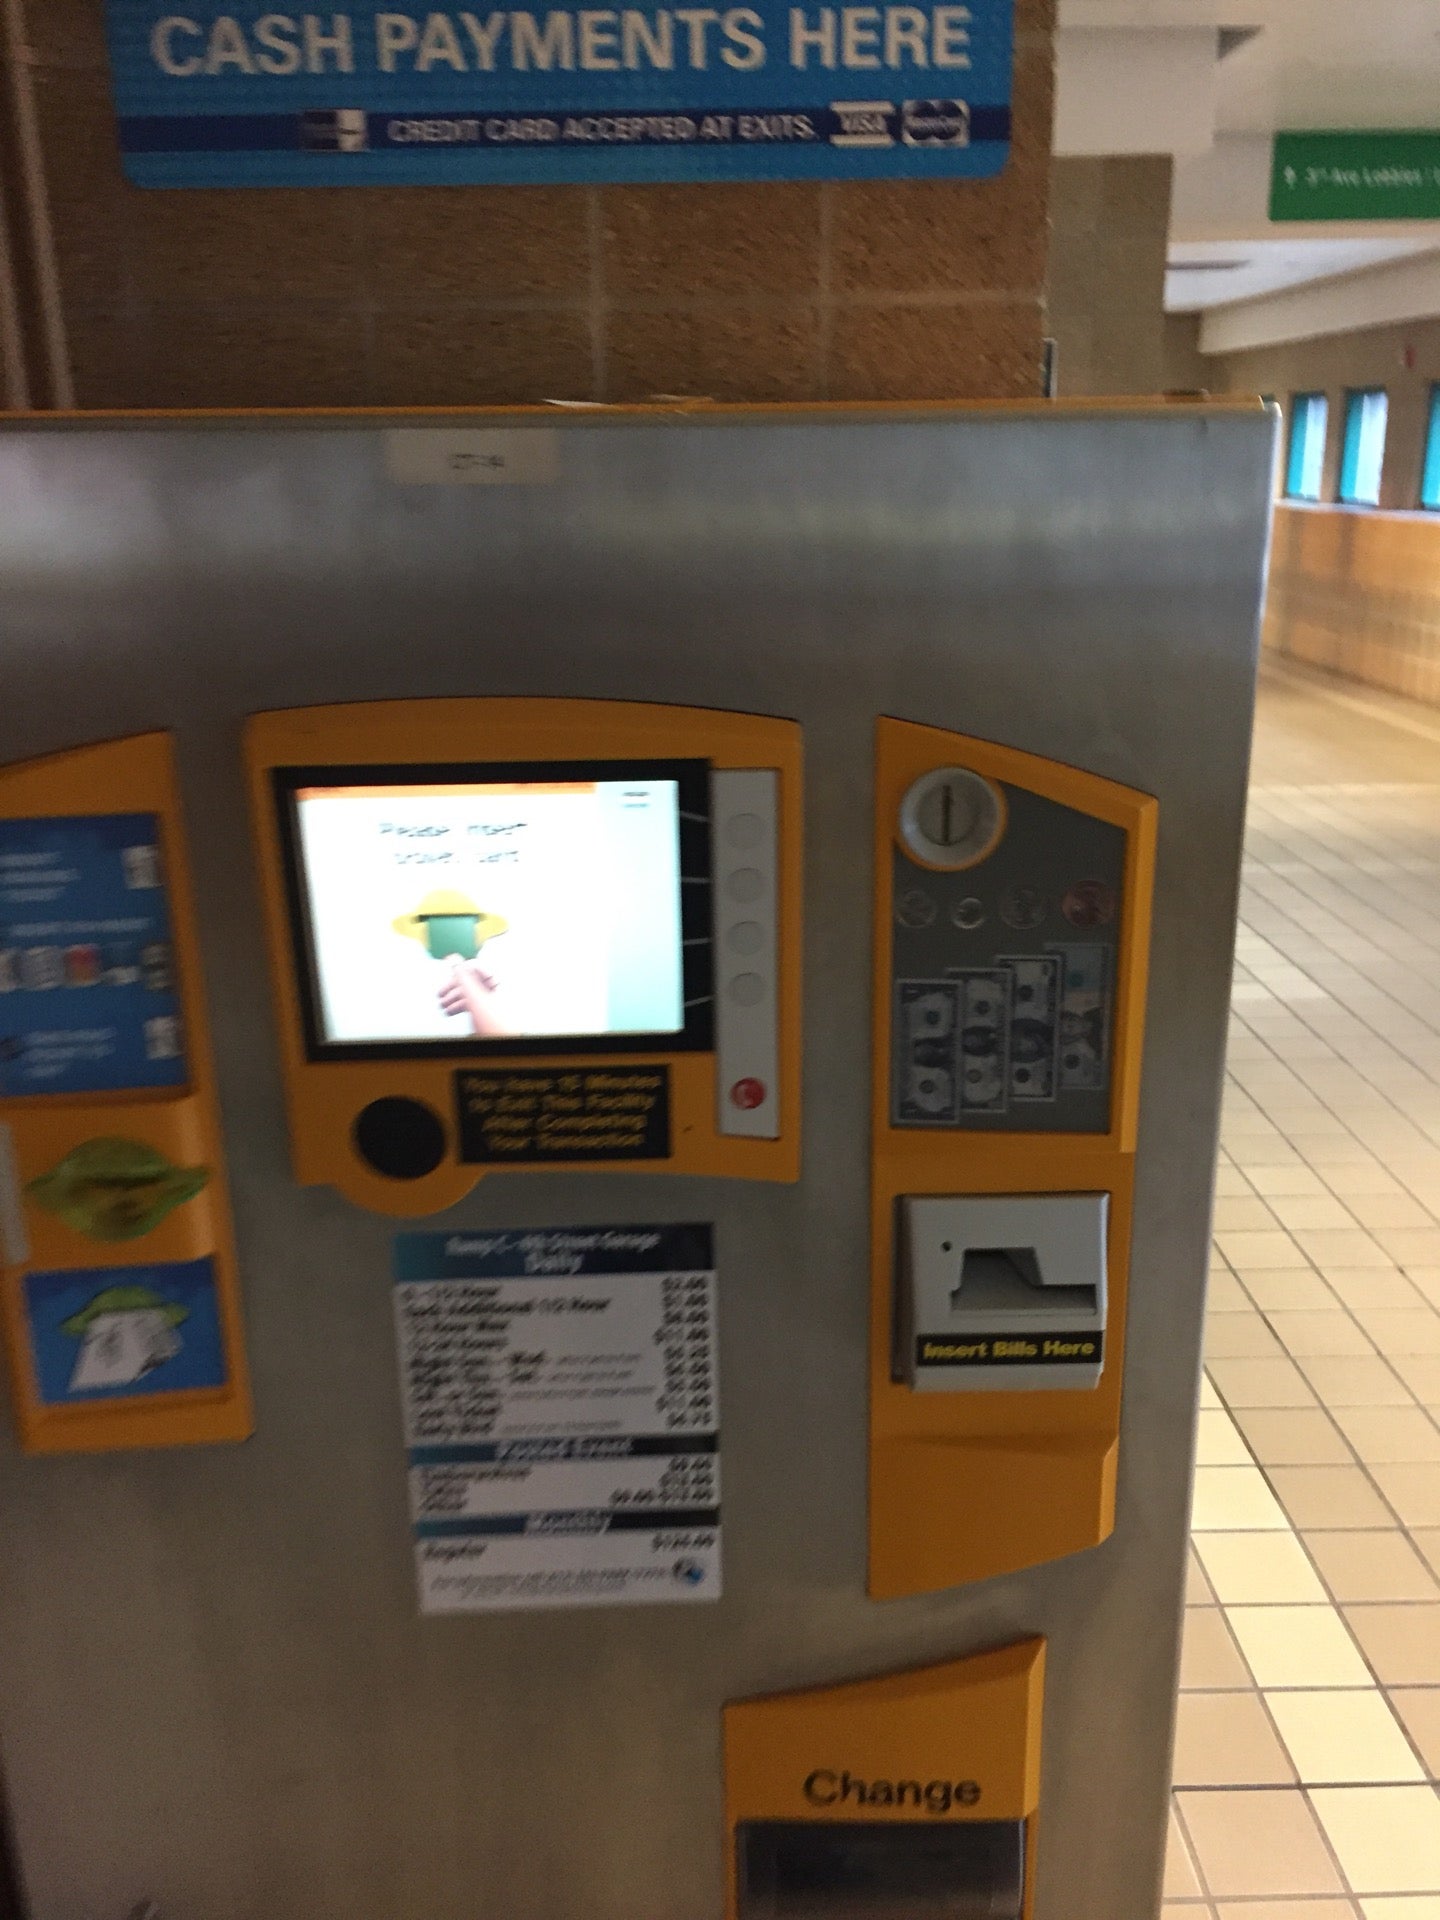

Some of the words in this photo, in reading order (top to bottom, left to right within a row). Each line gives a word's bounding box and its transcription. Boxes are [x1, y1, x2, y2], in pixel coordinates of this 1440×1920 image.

[150, 14, 354, 76] CASH
[375, 8, 765, 72] PAYMENTS
[789, 5, 972, 69] HERE
[388, 119, 481, 142] CREDIT
[484, 118, 558, 141] CARD
[562, 116, 697, 141] ACCEPTED
[699, 115, 735, 140] AT
[922, 1341, 988, 1361] Insert
[991, 1339, 1038, 1359] Bills
[1041, 1338, 1096, 1358] Here
[802, 1767, 982, 1813] Change
